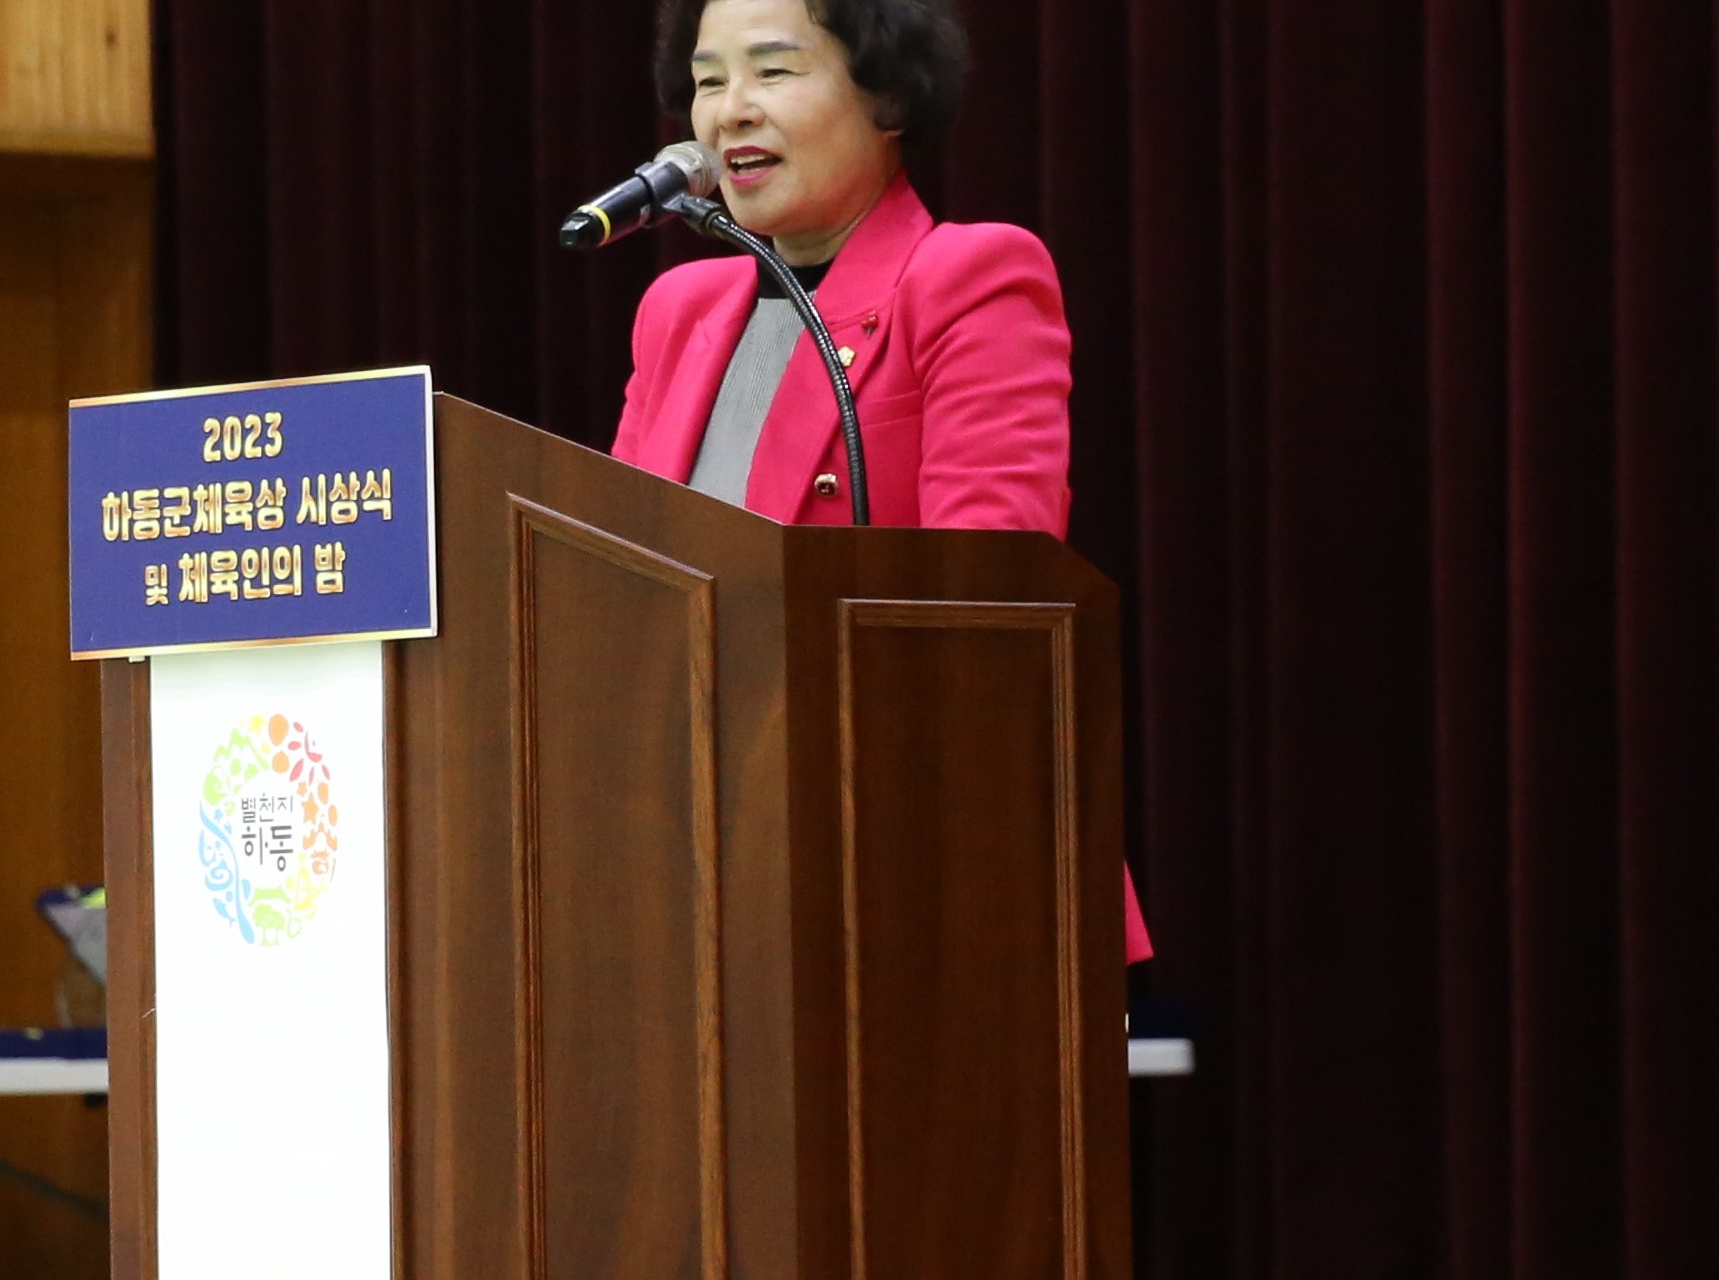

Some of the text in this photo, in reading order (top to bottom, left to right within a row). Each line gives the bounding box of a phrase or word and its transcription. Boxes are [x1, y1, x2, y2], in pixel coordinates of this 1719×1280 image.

[202, 410, 284, 463] 2023
[100, 468, 393, 542] 하동군체육상 시상식
[144, 541, 346, 606] 및 체육인의 밤
[241, 792, 293, 824] 별천지
[241, 825, 294, 872] 하동
